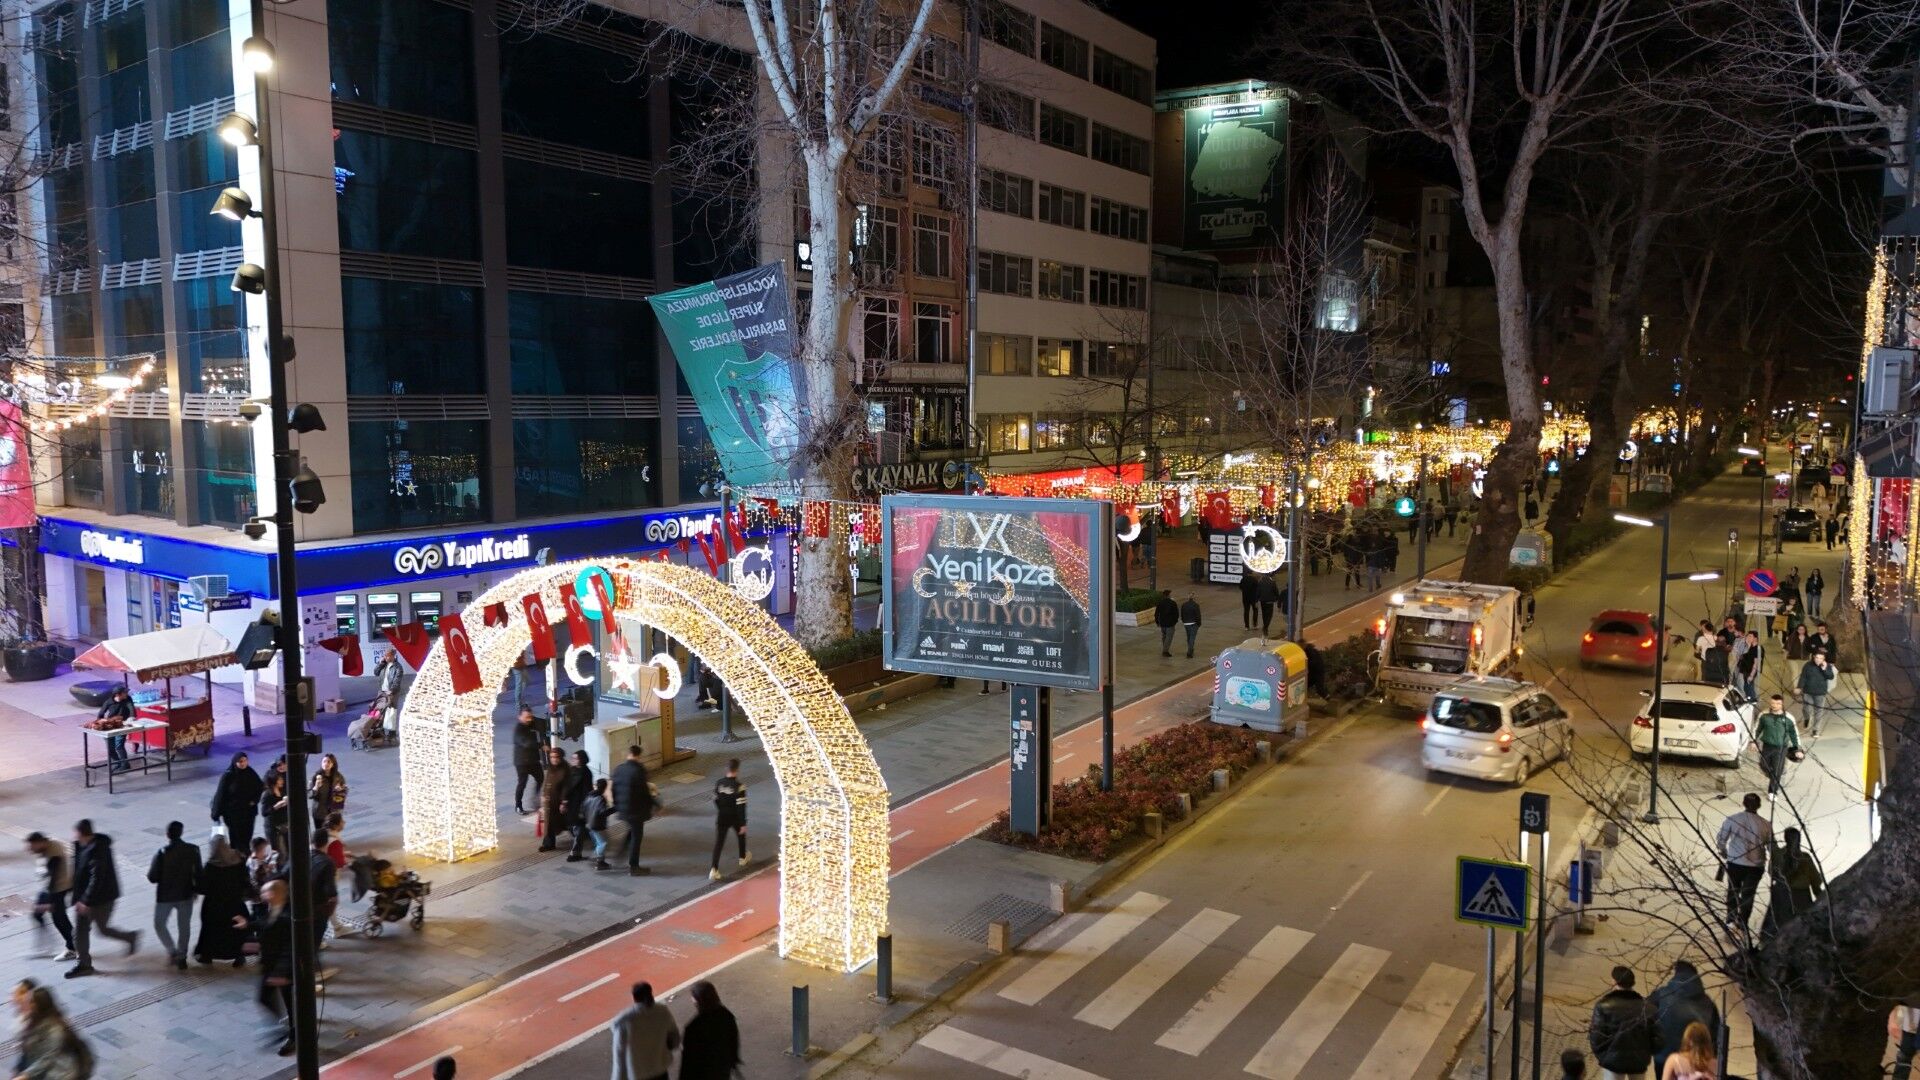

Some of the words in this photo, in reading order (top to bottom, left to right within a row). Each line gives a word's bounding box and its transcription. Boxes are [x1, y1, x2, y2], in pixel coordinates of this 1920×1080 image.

[866, 462, 939, 490] KAYNAK
[443, 533, 529, 568] YapıKredi
[927, 553, 982, 580] Yeni
[986, 556, 1056, 587] Koza
[926, 598, 1056, 629] AÇILIYOR
[982, 642, 1005, 653] mavi
[1046, 646, 1062, 657] LOFT
[1031, 659, 1063, 669] GUESS
